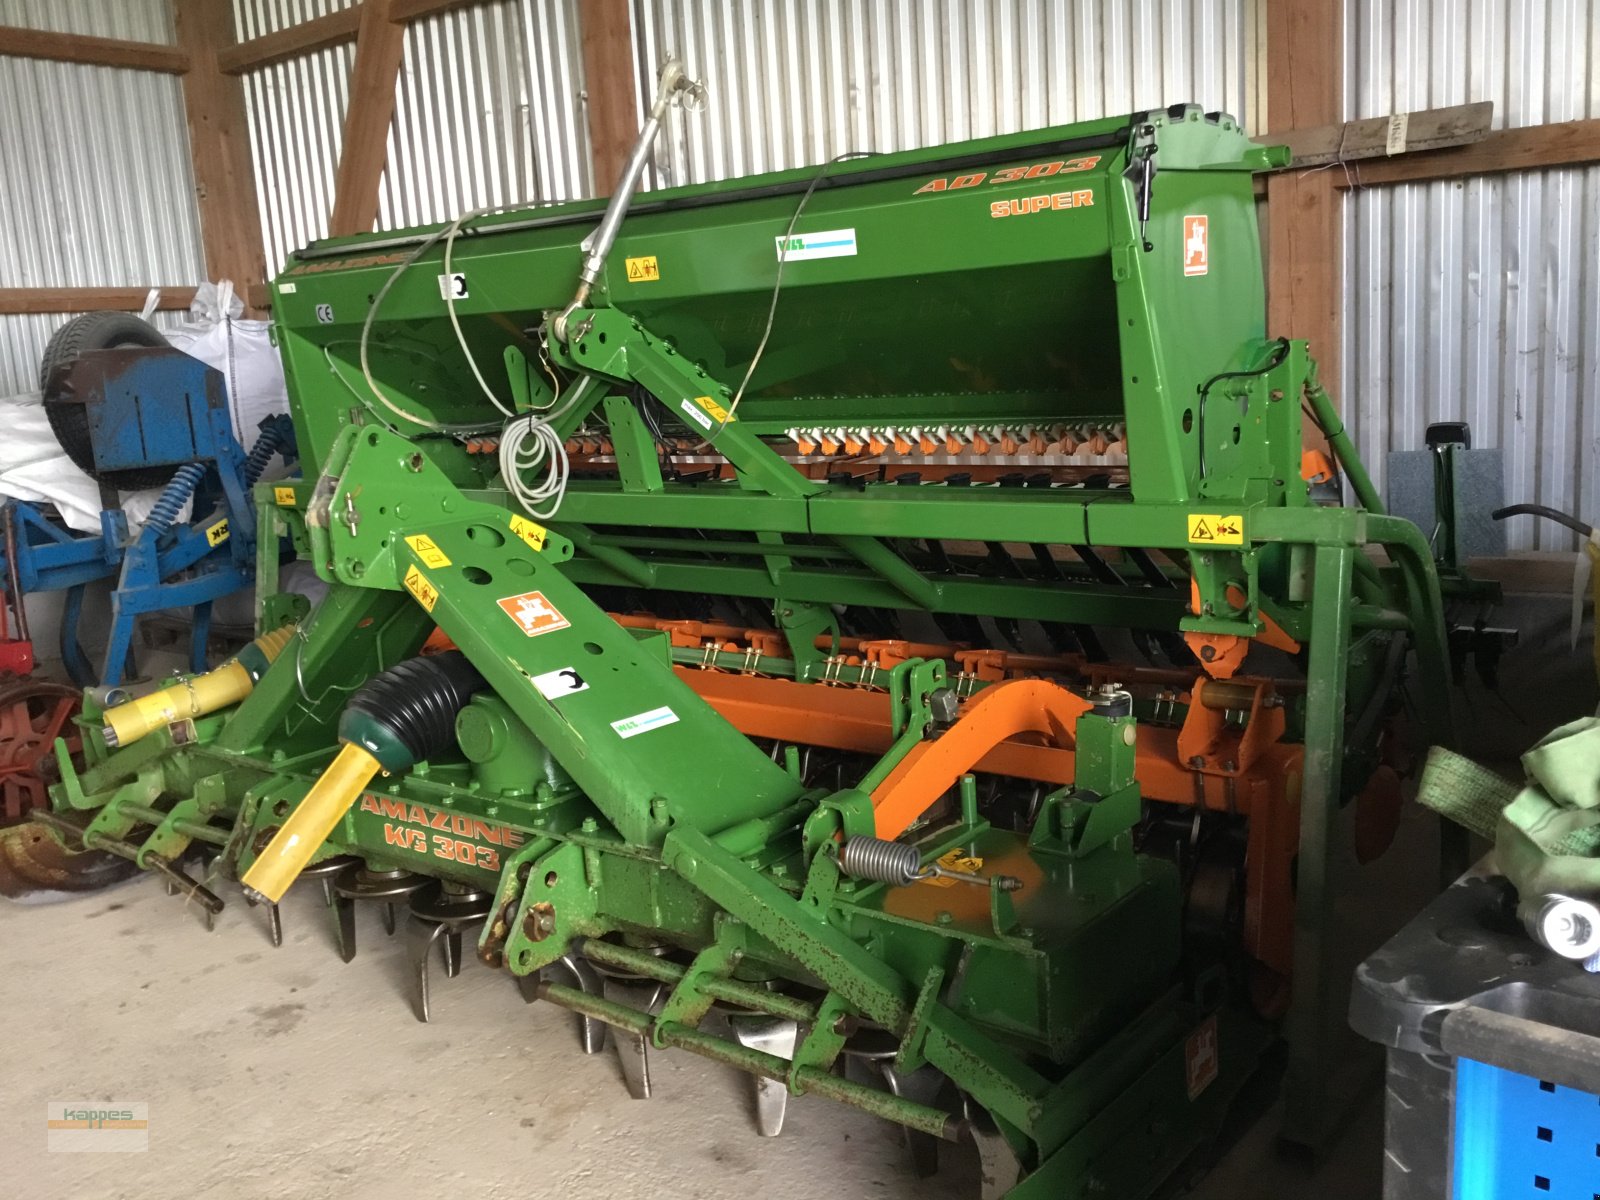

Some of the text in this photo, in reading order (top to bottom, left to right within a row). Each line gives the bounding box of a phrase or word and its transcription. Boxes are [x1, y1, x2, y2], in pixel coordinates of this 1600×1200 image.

[912, 155, 1102, 196] AD 303
[990, 189, 1095, 218] SUPER
[317, 305, 333, 322] CE
[360, 792, 526, 849] AMAZONE
[383, 822, 501, 872] KG 303
